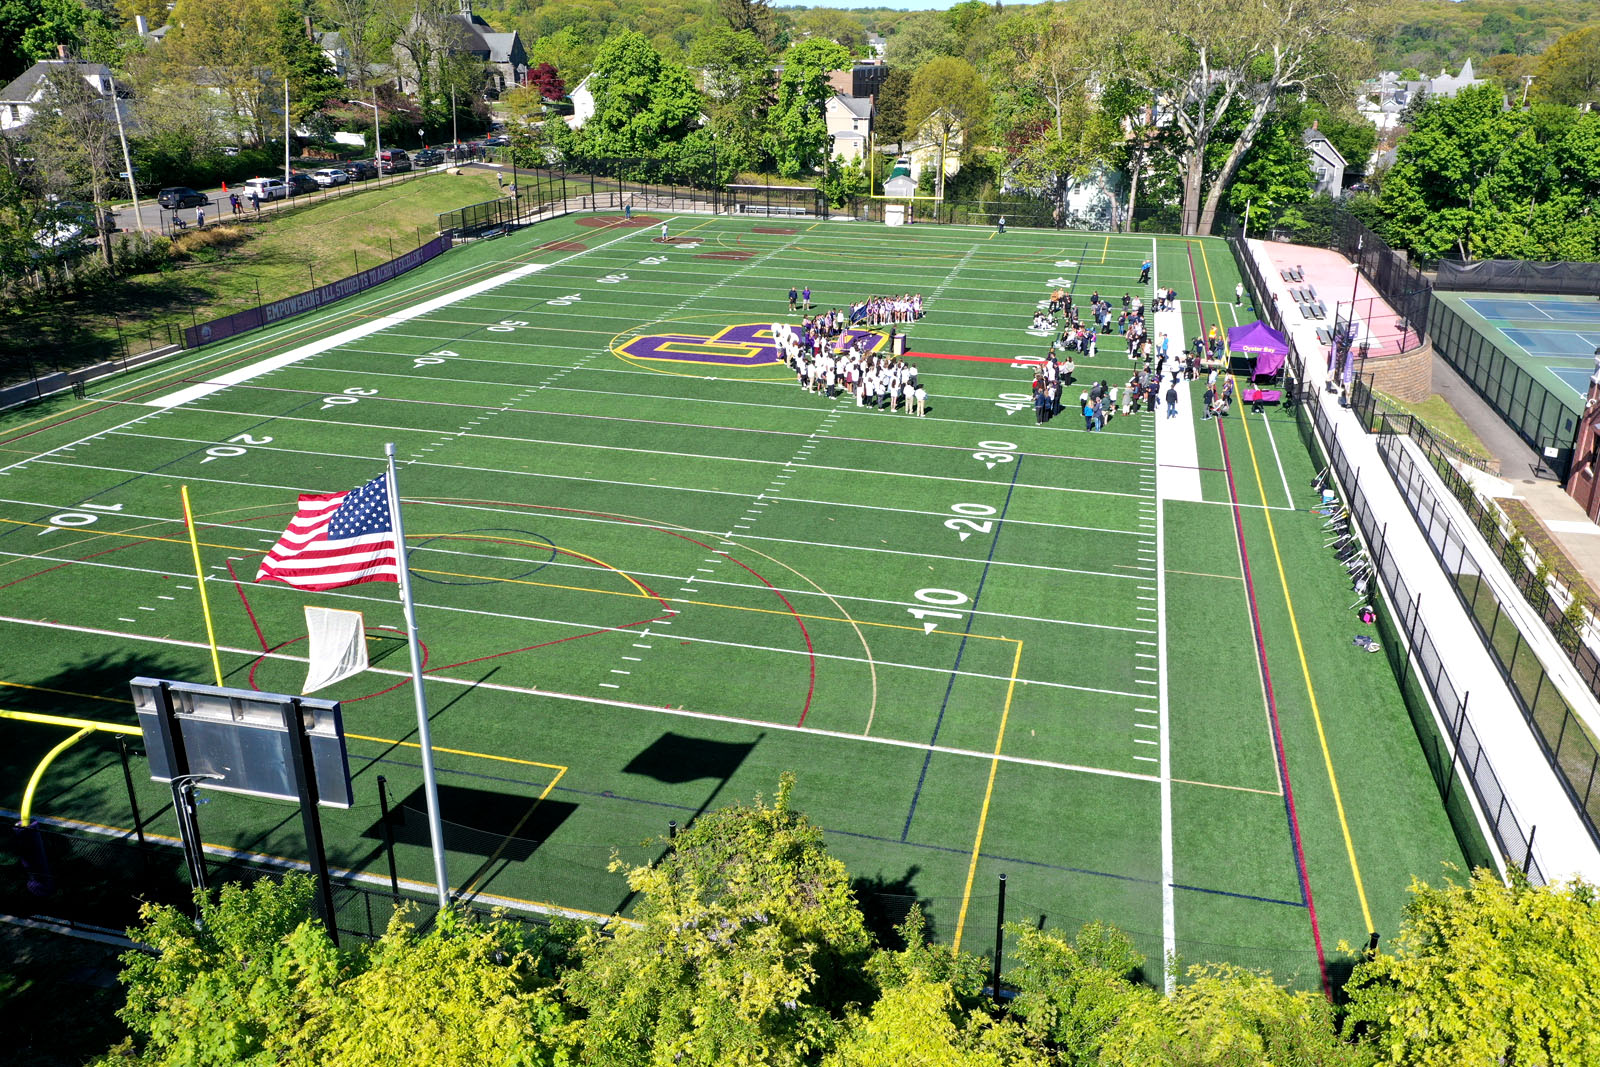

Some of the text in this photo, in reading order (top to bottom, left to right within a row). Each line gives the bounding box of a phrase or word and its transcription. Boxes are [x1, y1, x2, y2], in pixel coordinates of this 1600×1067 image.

[596, 274, 628, 283] 30
[265, 290, 320, 321] EMPOWERING
[321, 285, 336, 302] ALL
[335, 273, 369, 297] STUDENTS
[369, 270, 376, 284] TO
[546, 295, 581, 305] 40
[487, 320, 529, 332] 50
[414, 350, 459, 364] 40
[1263, 346, 1275, 354] Bay
[323, 387, 379, 404] 30
[995, 393, 1034, 411] 40
[205, 434, 273, 457] 20
[973, 440, 1018, 463] 30
[50, 504, 123, 526] 10
[944, 503, 997, 533] 20
[907, 588, 968, 619] 10
